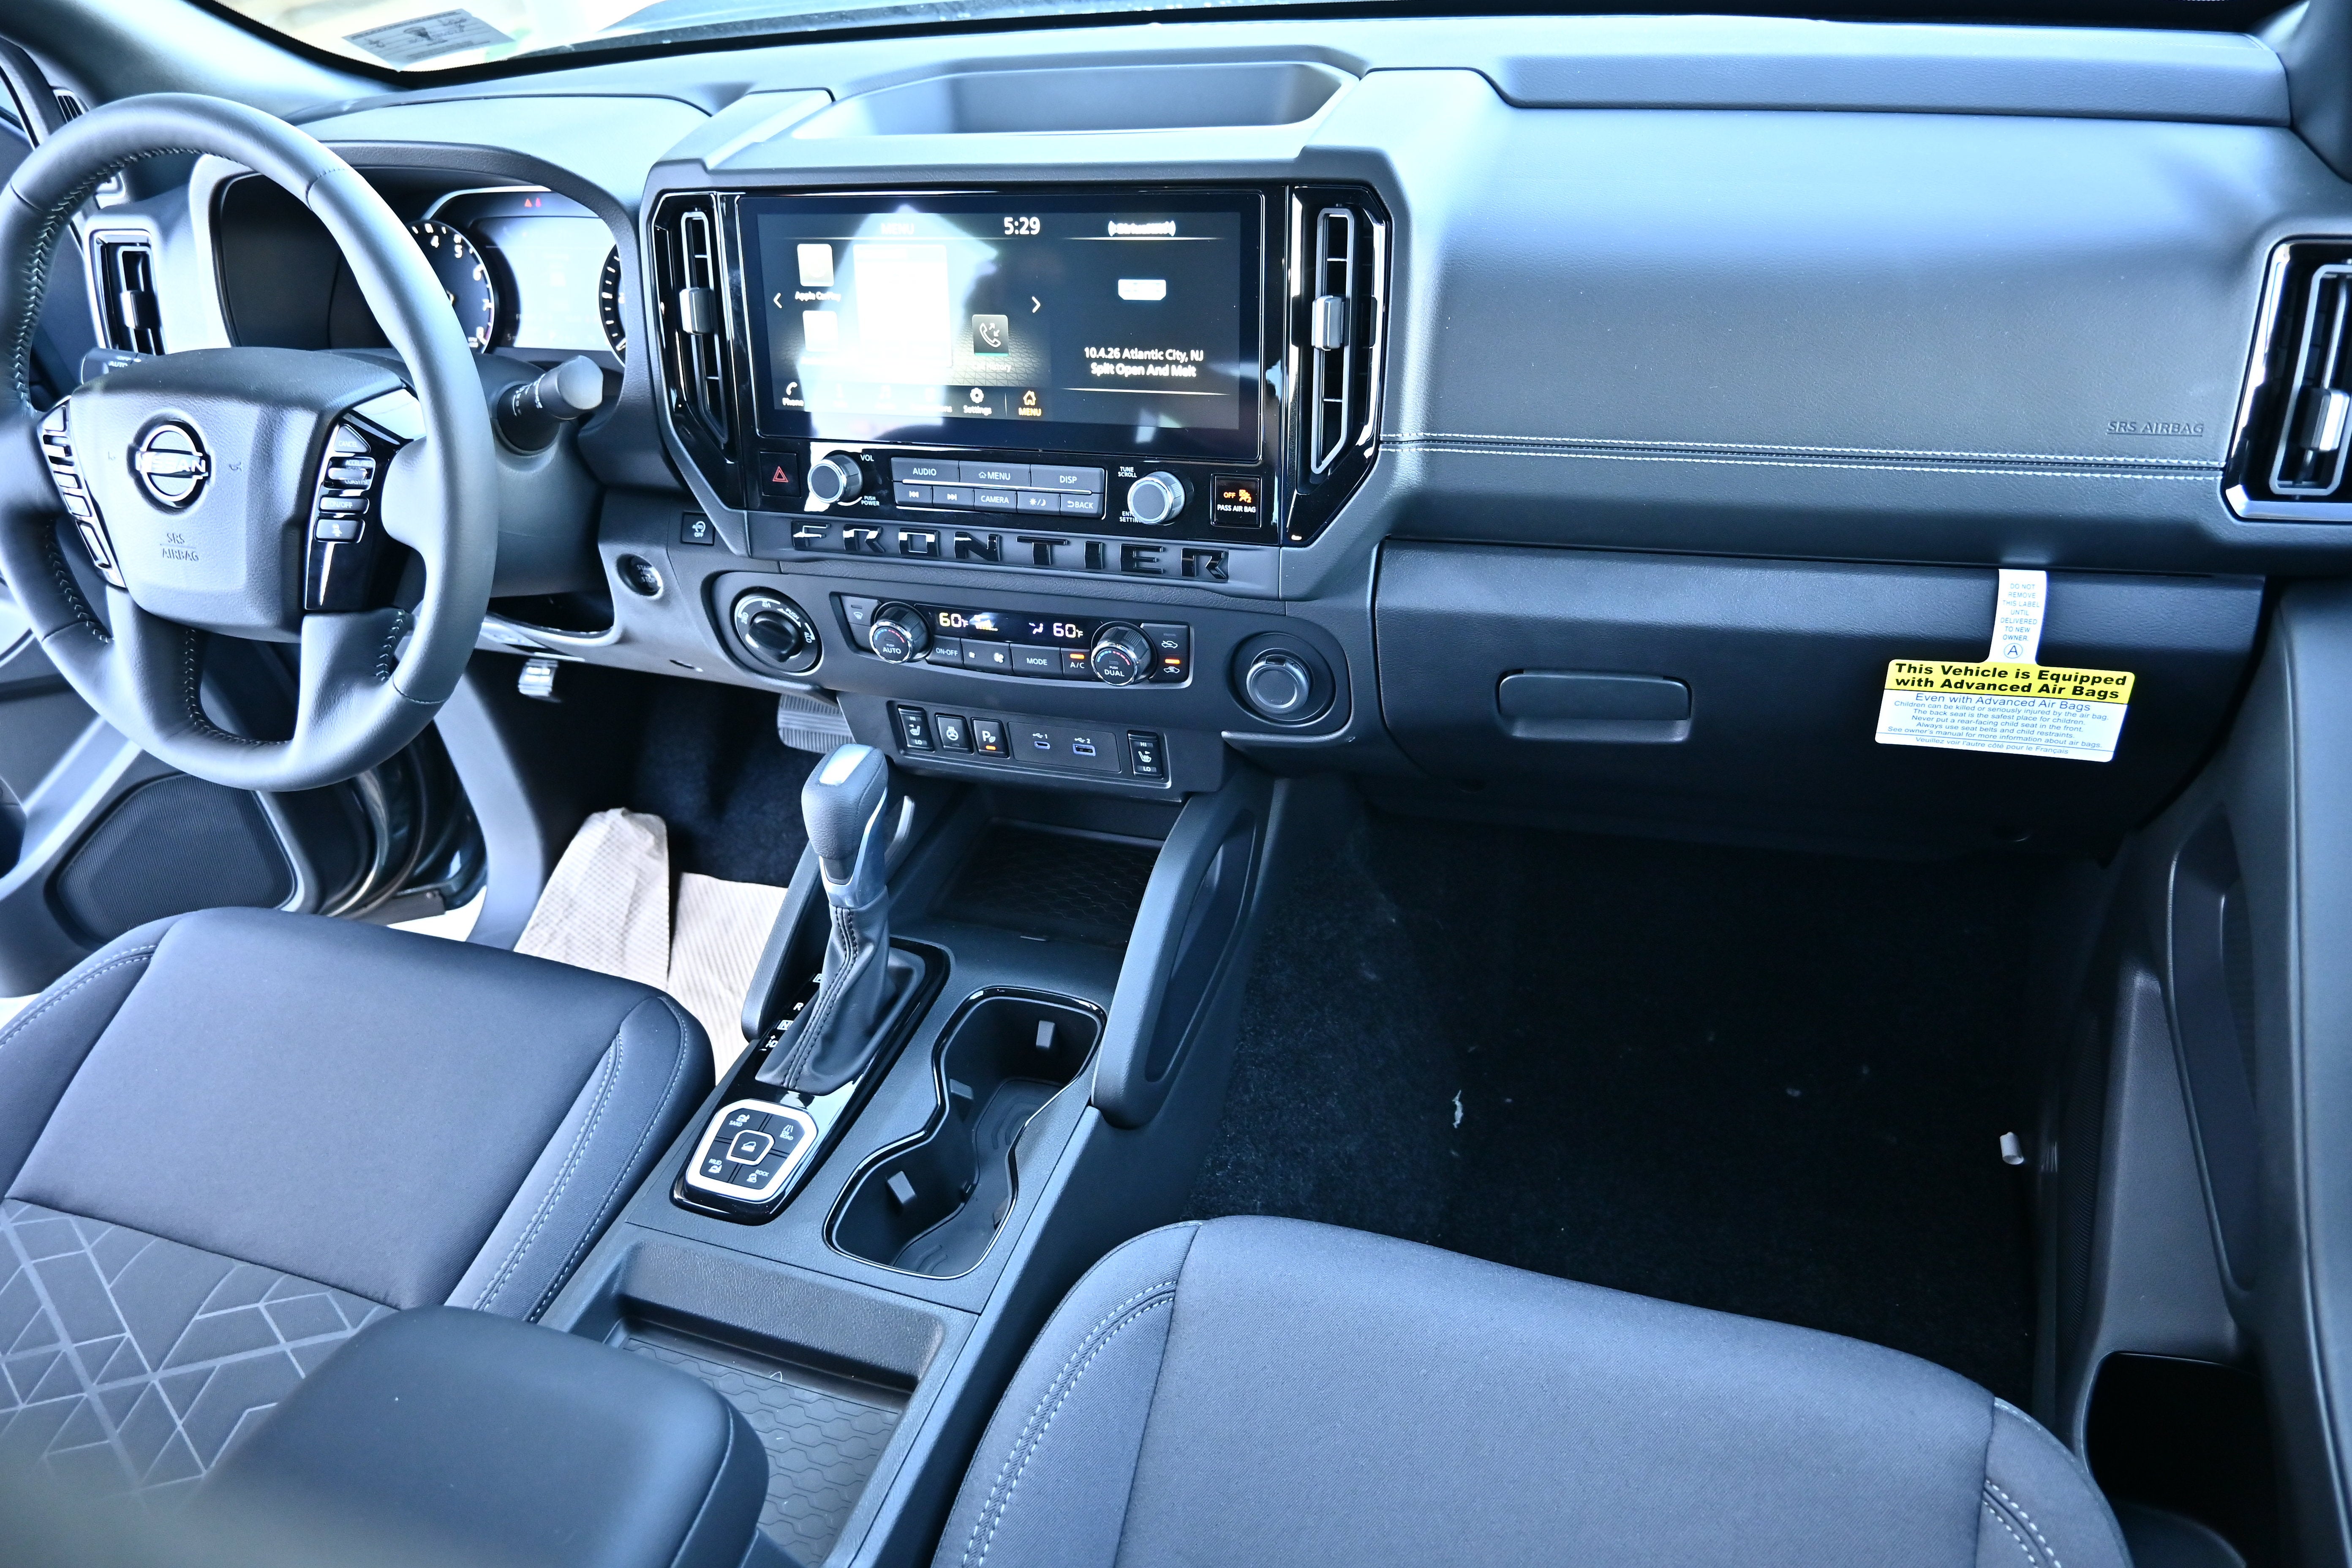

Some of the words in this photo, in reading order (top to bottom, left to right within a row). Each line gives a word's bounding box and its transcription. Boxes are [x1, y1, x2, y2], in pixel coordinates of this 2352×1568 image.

[881, 223, 915, 235] MENU
[1004, 217, 1040, 235] 5:29
[455, 245, 463, 258] 5
[1084, 347, 1120, 359] 10.4.26
[1122, 348, 1164, 360] Atlantic
[1165, 349, 1188, 363] City,
[1190, 350, 1203, 361] NJ
[1091, 362, 1114, 376] Split
[1116, 363, 1145, 377] Open
[1146, 364, 1169, 376] And
[1171, 365, 1196, 377] Melt
[963, 405, 992, 416] Settings
[1018, 407, 1042, 416] MENU
[2107, 422, 2136, 433] SRS
[2140, 422, 2205, 434] AIRBAG
[860, 454, 874, 462] VOL
[912, 467, 937, 476] AUDIO
[988, 471, 1011, 481] MENU
[1059, 475, 1078, 484] DISP
[980, 495, 1009, 504] CAMERA
[1075, 501, 1094, 509] BACK
[167, 533, 185, 544] SRS
[162, 548, 199, 561] AIRBAG
[791, 520, 1230, 583] FRONTIER
[786, 608, 800, 620] PUSH
[804, 632, 812, 643] 4LO
[882, 647, 901, 655] AUTO
[935, 648, 958, 656] ON-OFF
[2007, 645, 2018, 655] A
[1026, 657, 1048, 666] MODE
[1104, 669, 1125, 677] DUAL
[1896, 663, 1933, 675] This
[1941, 665, 2008, 678] Vehicle
[2015, 669, 2030, 679] is
[2037, 670, 2127, 686] Equipped
[1896, 677, 1934, 687] with
[1940, 679, 2032, 692] Advanced
[2037, 683, 2066, 694] Air
[2072, 686, 2119, 700] Bags
[1916, 693, 1944, 702] Even
[1949, 695, 1972, 703] with
[1976, 696, 2036, 707] Advanced
[2038, 700, 2055, 708] Air
[2060, 701, 2090, 712] Bags
[2053, 717, 2085, 725] children.
[2037, 730, 2074, 738] restraints.
[2036, 746, 2069, 754] Français
[2081, 741, 2102, 749] bags.
[793, 1002, 804, 1011] R
